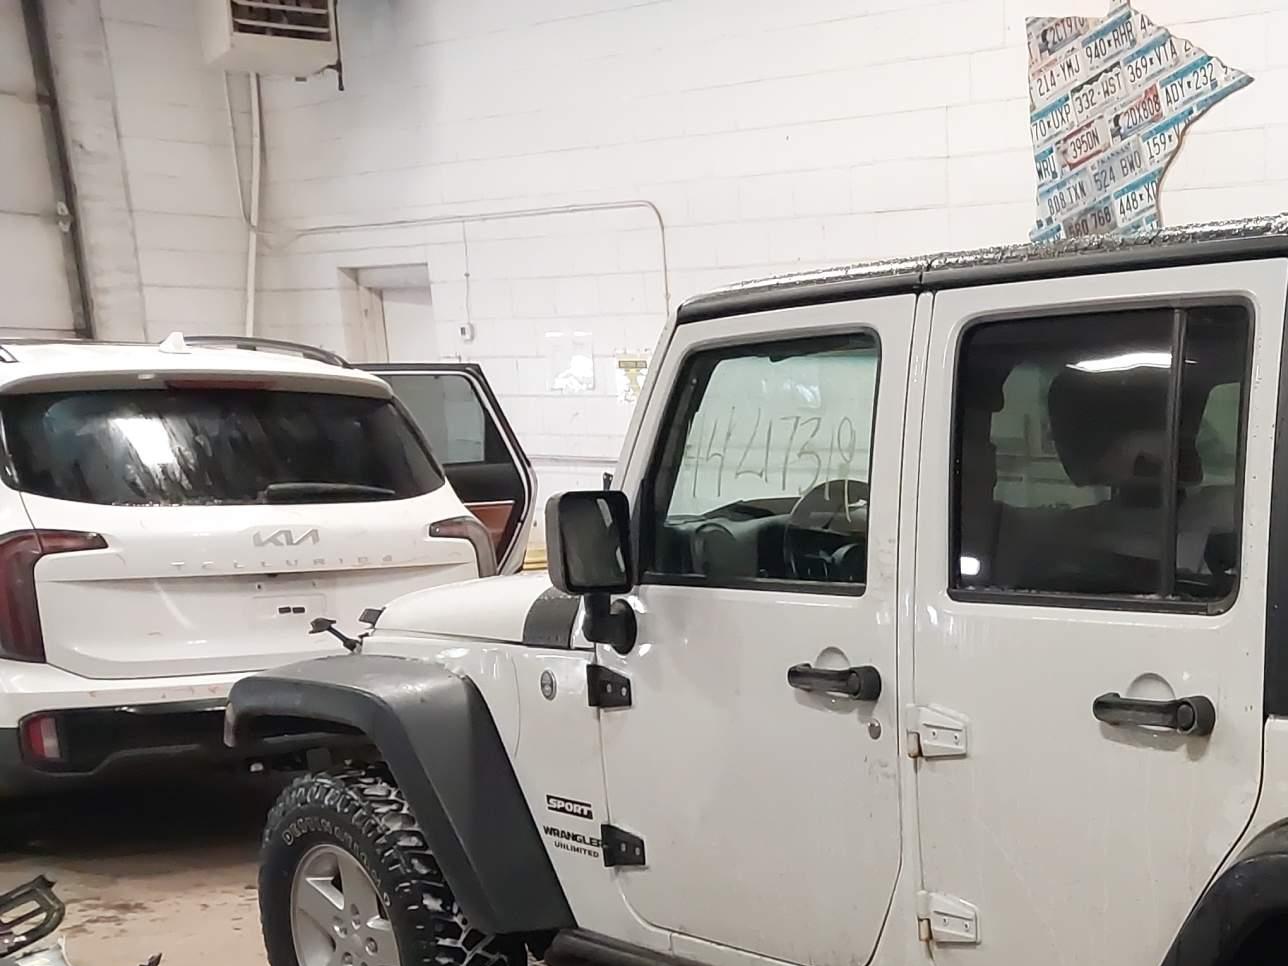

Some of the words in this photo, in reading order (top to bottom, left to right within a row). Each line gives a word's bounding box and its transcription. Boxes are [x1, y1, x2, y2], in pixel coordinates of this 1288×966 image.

[1093, 165, 1116, 192] 524
[1119, 191, 1139, 216] 448
[252, 528, 321, 547] KIA
[170, 554, 393, 570] TELLURIDE
[548, 797, 592, 817] SPORT
[554, 840, 600, 858] UNLIMITED
